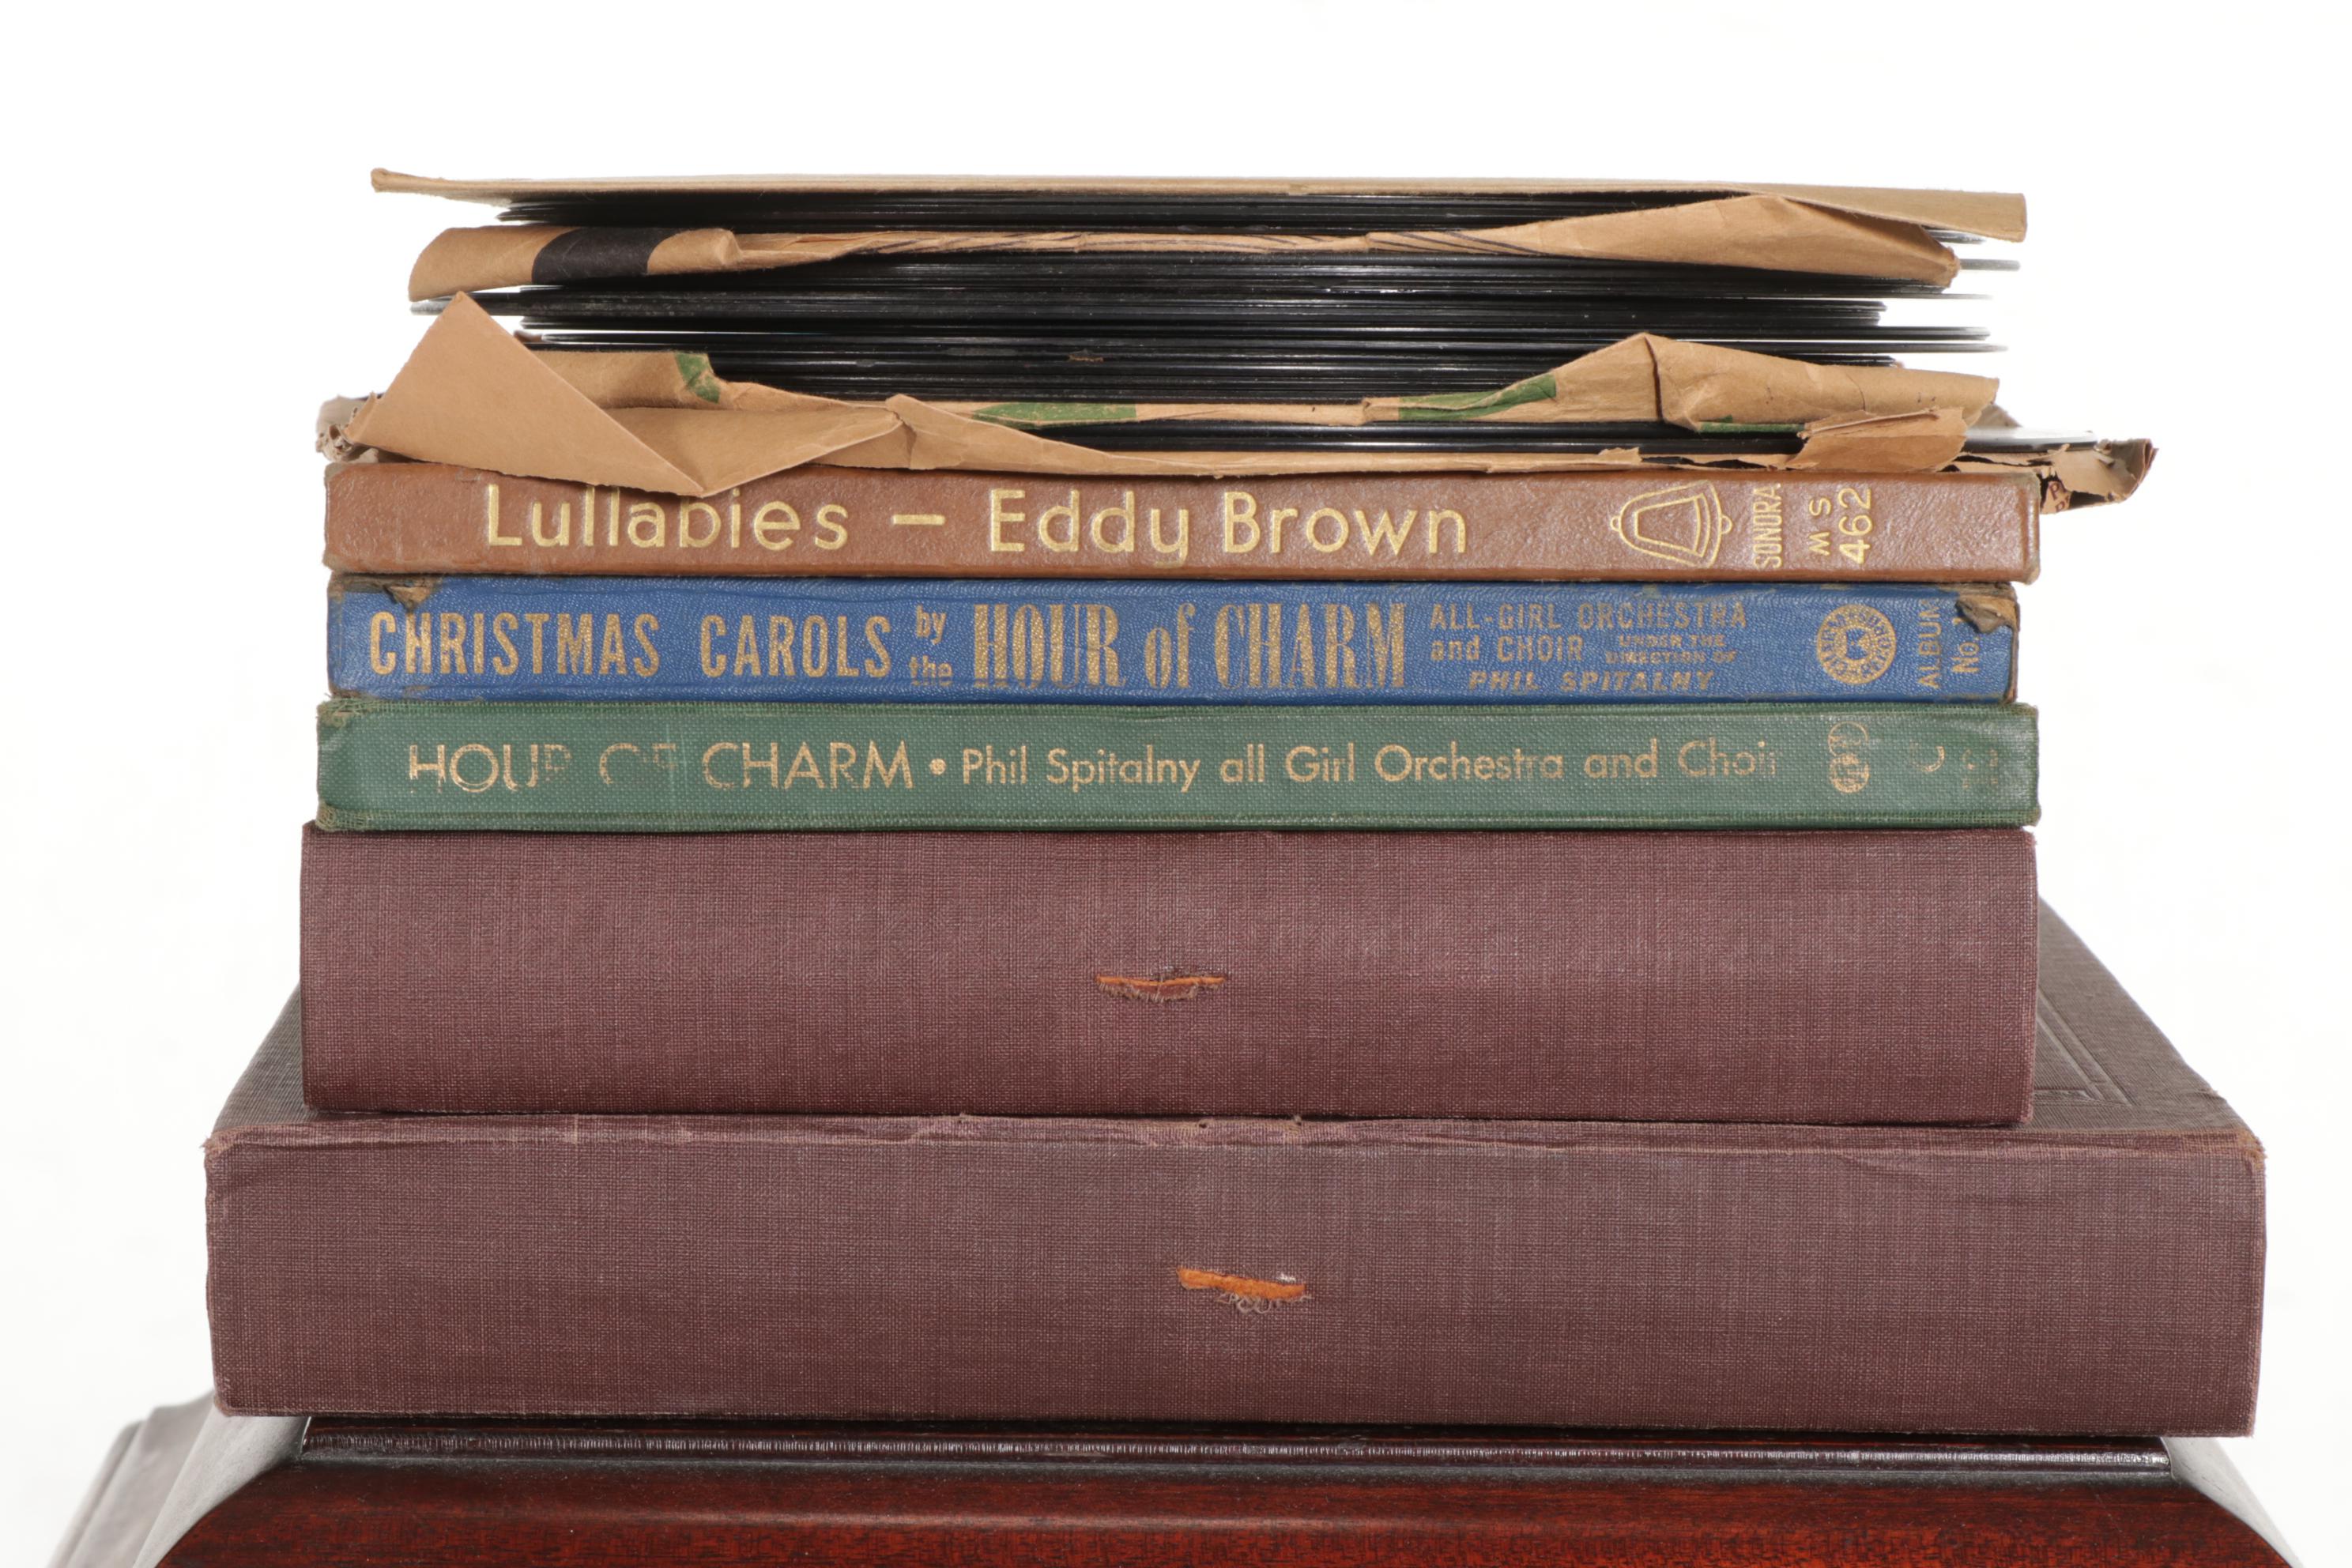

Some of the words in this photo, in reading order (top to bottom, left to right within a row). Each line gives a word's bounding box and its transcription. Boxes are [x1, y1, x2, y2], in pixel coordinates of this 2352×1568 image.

[485, 482, 850, 551] Lullabies
[989, 488, 1189, 567] Eddy
[1223, 491, 1468, 555] Brown
[1752, 483, 1783, 569] SONORA
[1838, 488, 1873, 564] 462
[915, 605, 947, 645] by
[1430, 602, 1562, 631] ALL-GIRL
[1580, 602, 1747, 630] ORCHESTRA
[368, 611, 661, 677] CHRISTMAS
[699, 615, 892, 677] CAROLS
[974, 604, 1125, 689] HOUR
[1144, 604, 1196, 690] of
[1214, 603, 1407, 689] CHARM
[1430, 635, 1480, 661] and
[1497, 635, 1584, 662] CHOIR
[1619, 635, 1683, 648] UNDER
[1689, 635, 1726, 647] THE
[1713, 650, 1738, 663] OF
[1917, 598, 1942, 690] ALBUM
[908, 654, 953, 687] the
[1468, 670, 1540, 692] PHIL
[1559, 670, 1715, 692] SPITALNY
[702, 741, 914, 790] CHARM
[963, 745, 1028, 784] Phil
[1046, 745, 1200, 792] Spitalny
[1220, 744, 1265, 783] all
[1284, 743, 1355, 782] Girl
[1374, 741, 1563, 782] Orchestra
[1584, 739, 1659, 779] and
